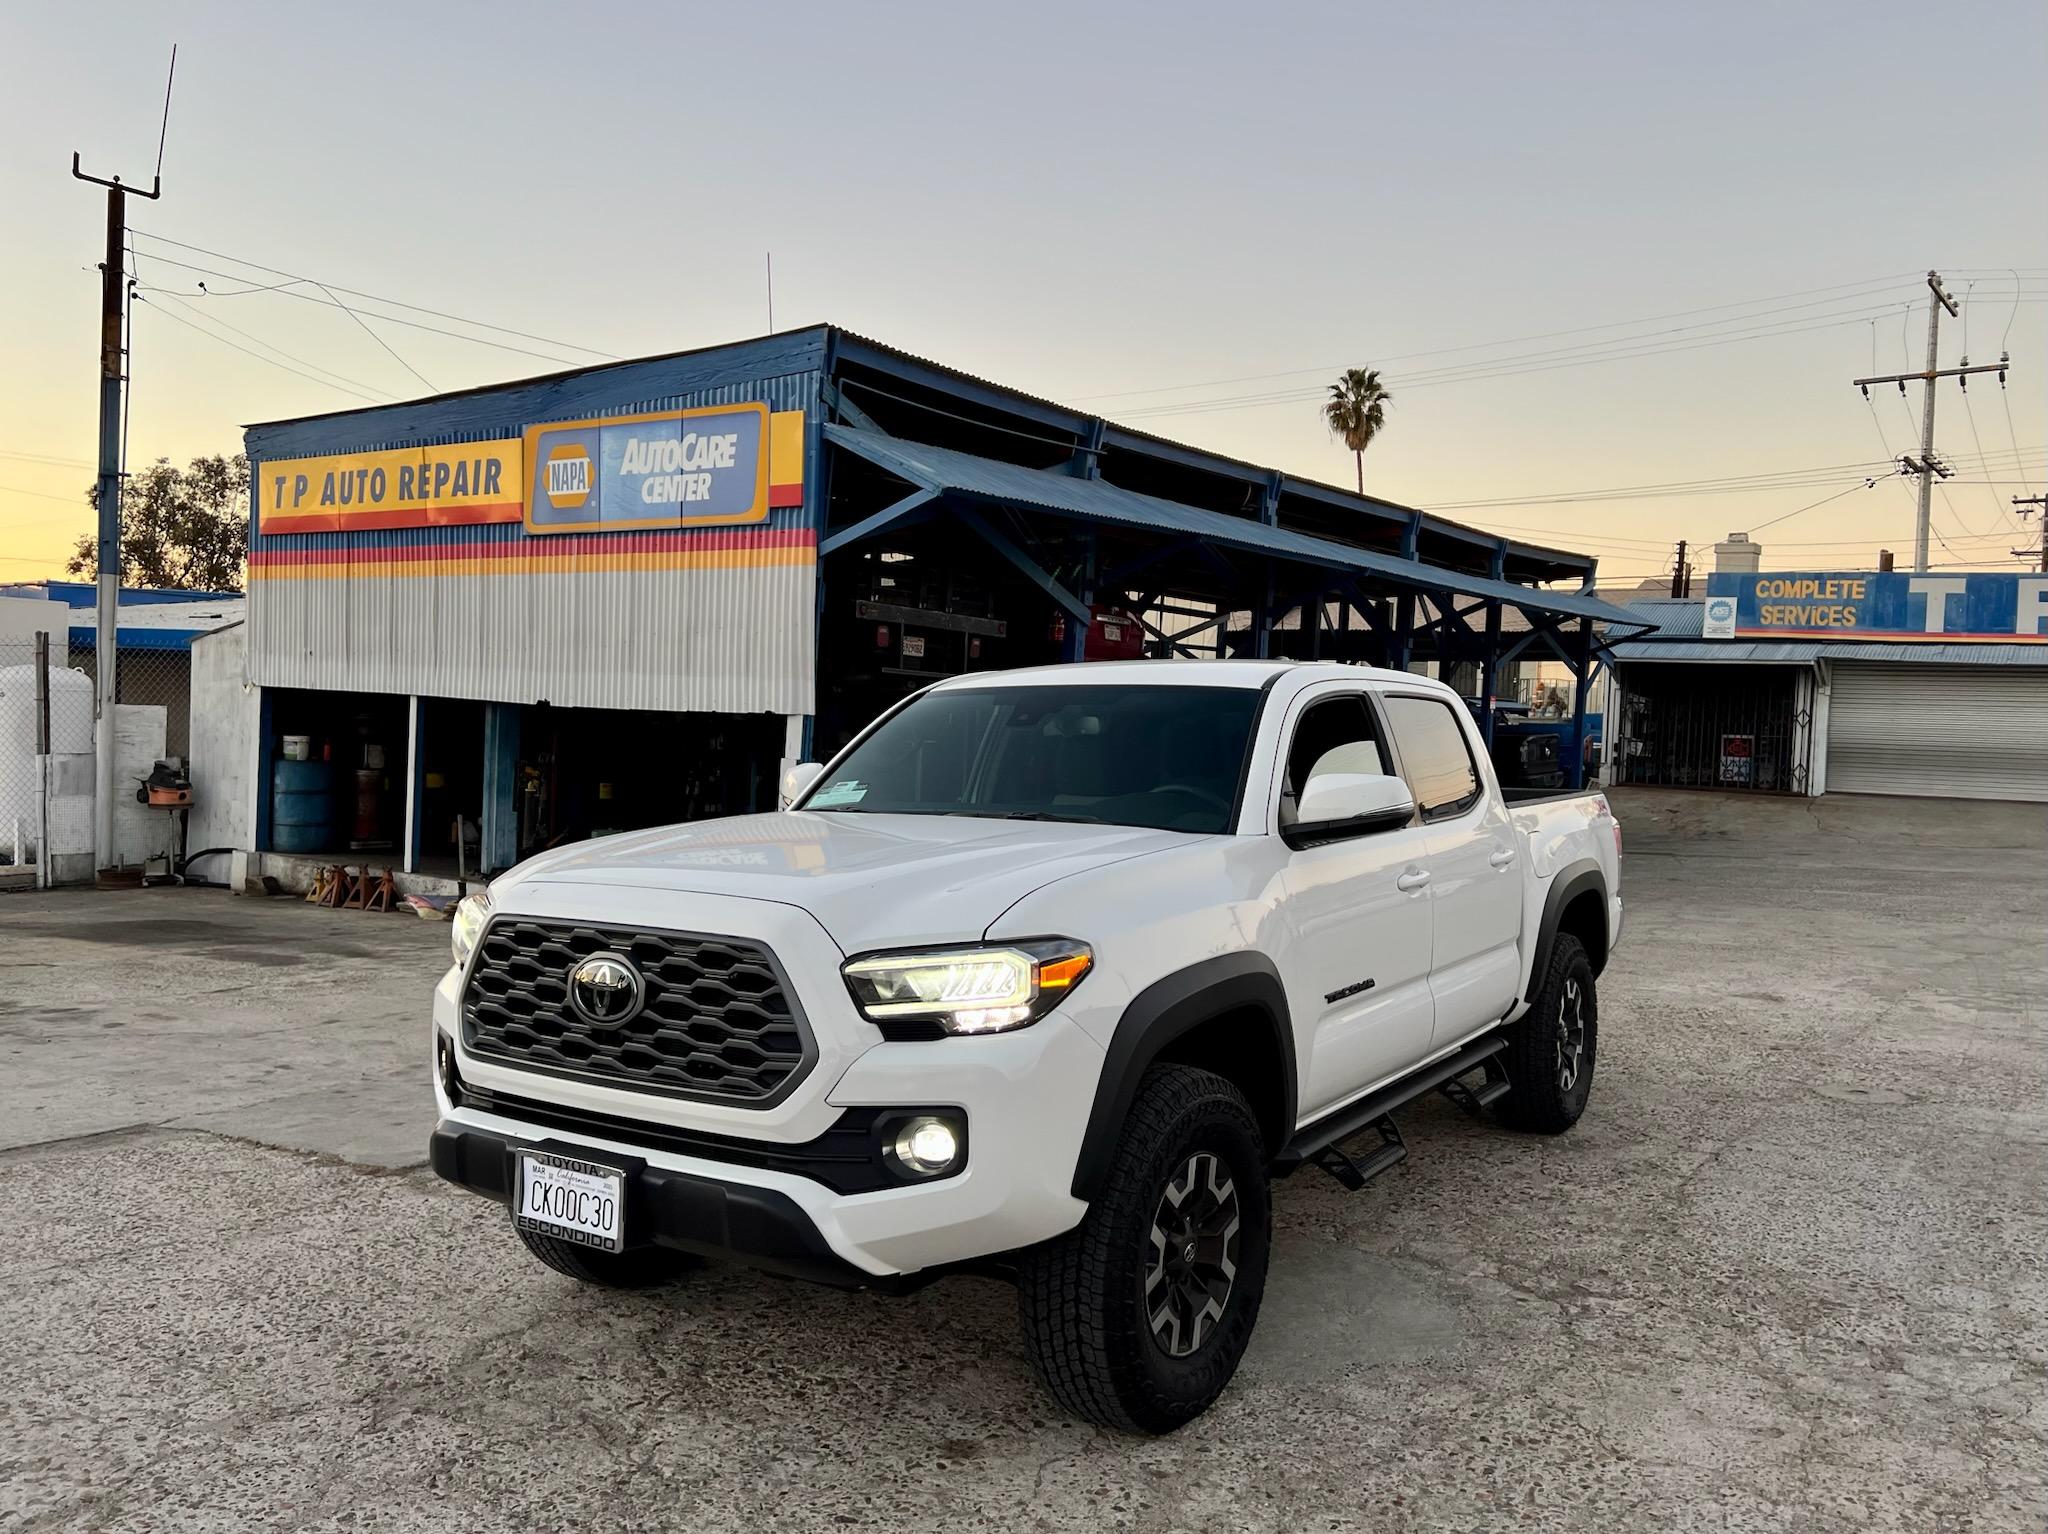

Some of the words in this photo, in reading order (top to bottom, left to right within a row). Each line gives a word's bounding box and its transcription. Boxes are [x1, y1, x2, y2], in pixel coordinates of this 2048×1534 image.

[275, 476, 287, 509] T
[293, 474, 309, 508] P
[320, 467, 386, 506] AUTO
[399, 458, 502, 501] REPAIR
[551, 461, 586, 492] NAPA
[641, 472, 712, 504] CENTER
[1755, 579, 1866, 599] COMPLETE
[1909, 578, 1966, 632] T
[532, 1165, 546, 1175] MAR
[546, 1156, 599, 1176] TOYOTA
[518, 1216, 615, 1250] ESCONDIDO
